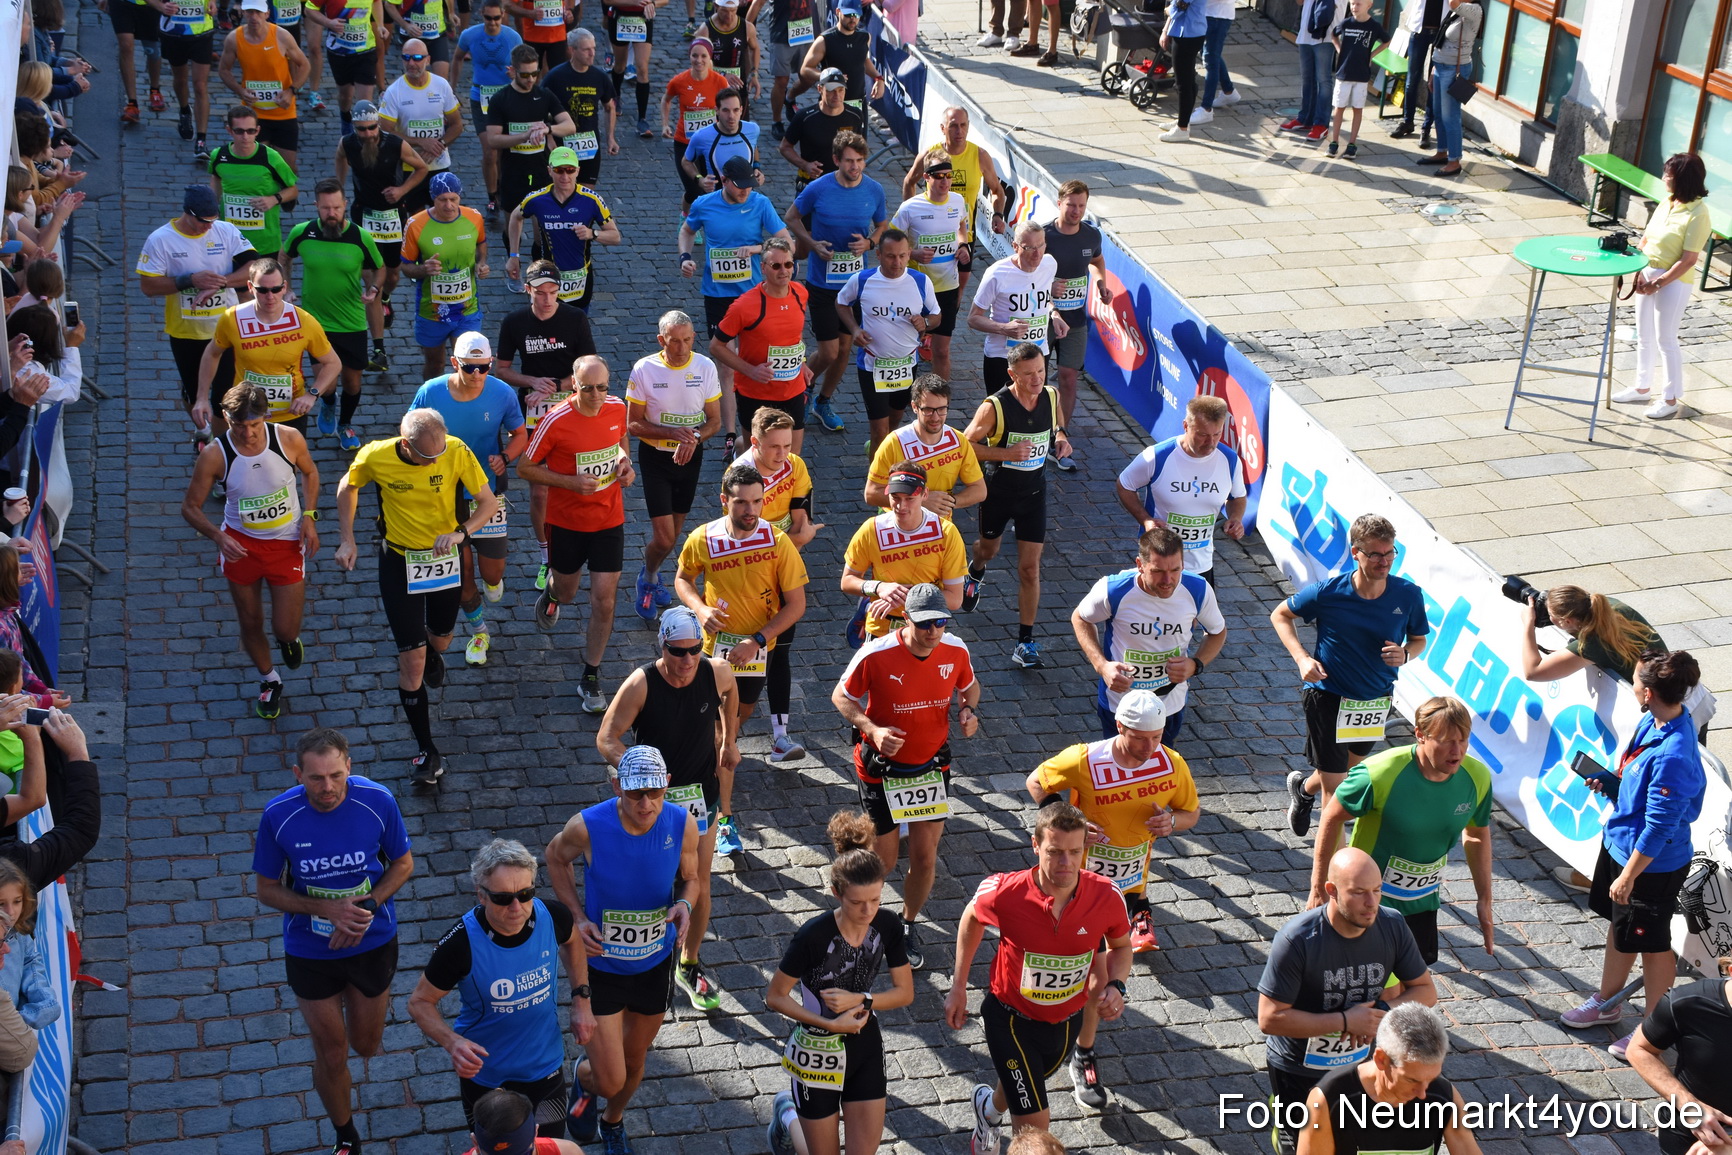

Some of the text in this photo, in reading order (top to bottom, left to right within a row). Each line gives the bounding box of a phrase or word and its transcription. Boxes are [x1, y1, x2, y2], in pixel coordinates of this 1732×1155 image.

[175, 7, 202, 16] 2679
[543, 8, 561, 18] 160
[340, 33, 366, 41] 2685
[620, 25, 643, 34] 2575
[791, 27, 811, 37] 2825
[413, 129, 440, 139] 1023
[568, 140, 594, 151] 2120
[228, 206, 260, 219] 1156
[230, 219, 259, 227] TORSTEN
[367, 219, 398, 232] 1347
[923, 244, 953, 256] 764
[715, 258, 747, 272] 1018
[831, 260, 862, 273] 2818
[718, 272, 746, 280] MARKUS
[436, 280, 468, 294] 1278
[559, 279, 583, 291] 007
[241, 332, 305, 351] MAX BÖGL
[875, 356, 911, 369] BOCK
[1159, 354, 1181, 382] ONLINE
[248, 373, 288, 386] BOCK
[878, 367, 909, 381] 1293
[885, 381, 902, 389] AKIN
[1156, 380, 1178, 410] MOBILE
[664, 413, 702, 424] BOCK
[581, 445, 617, 463] BOCK
[583, 459, 616, 478] 1027
[922, 451, 963, 473] AX BÖGL
[1010, 459, 1041, 468] MICHAEL
[776, 477, 796, 495] BÖG
[1170, 475, 1220, 498] SUSPA
[243, 486, 287, 511] BOCK
[246, 501, 288, 522] 1405
[1170, 513, 1212, 526] BOCK
[481, 526, 507, 534] MARCO
[1171, 525, 1207, 541] 2531
[710, 550, 778, 573] MAX BÖGL
[881, 543, 946, 565] MAX BÖGL
[412, 560, 455, 580] 2737
[1279, 461, 1545, 735] slastar
[1129, 616, 1184, 641] SUSPA
[1128, 648, 1177, 663] BOCK
[1132, 664, 1169, 680] 253
[1346, 699, 1387, 710] BOCK
[1344, 712, 1382, 726] 1385
[887, 771, 940, 788] BOCK
[664, 786, 698, 801] OCK
[893, 786, 939, 807] 1297
[1095, 779, 1177, 806] MAX BÖGL
[903, 807, 937, 817] ALBERT
[1093, 844, 1145, 862] BOCK
[300, 850, 366, 874] SYSCAD
[1093, 859, 1141, 878] 2373
[1392, 855, 1446, 875] BOCK
[1389, 871, 1440, 888] 2705
[609, 907, 669, 923] BOCK
[609, 923, 662, 944] 2015
[610, 942, 658, 956] MANFRED
[1030, 954, 1089, 969] BOCK
[516, 967, 548, 986] LEIDL &
[517, 972, 552, 993] INDERST
[1031, 969, 1083, 989] 1252
[1323, 962, 1386, 991] MUD
[1031, 988, 1076, 1000] MICHAEL
[1322, 986, 1386, 1012] DER
[491, 1006, 515, 1014] TSG
[808, 1025, 830, 1036] 2XU
[789, 1044, 839, 1071] 1039
[1326, 1055, 1354, 1066] JÖRG
[785, 1061, 836, 1083] VERONIKA
